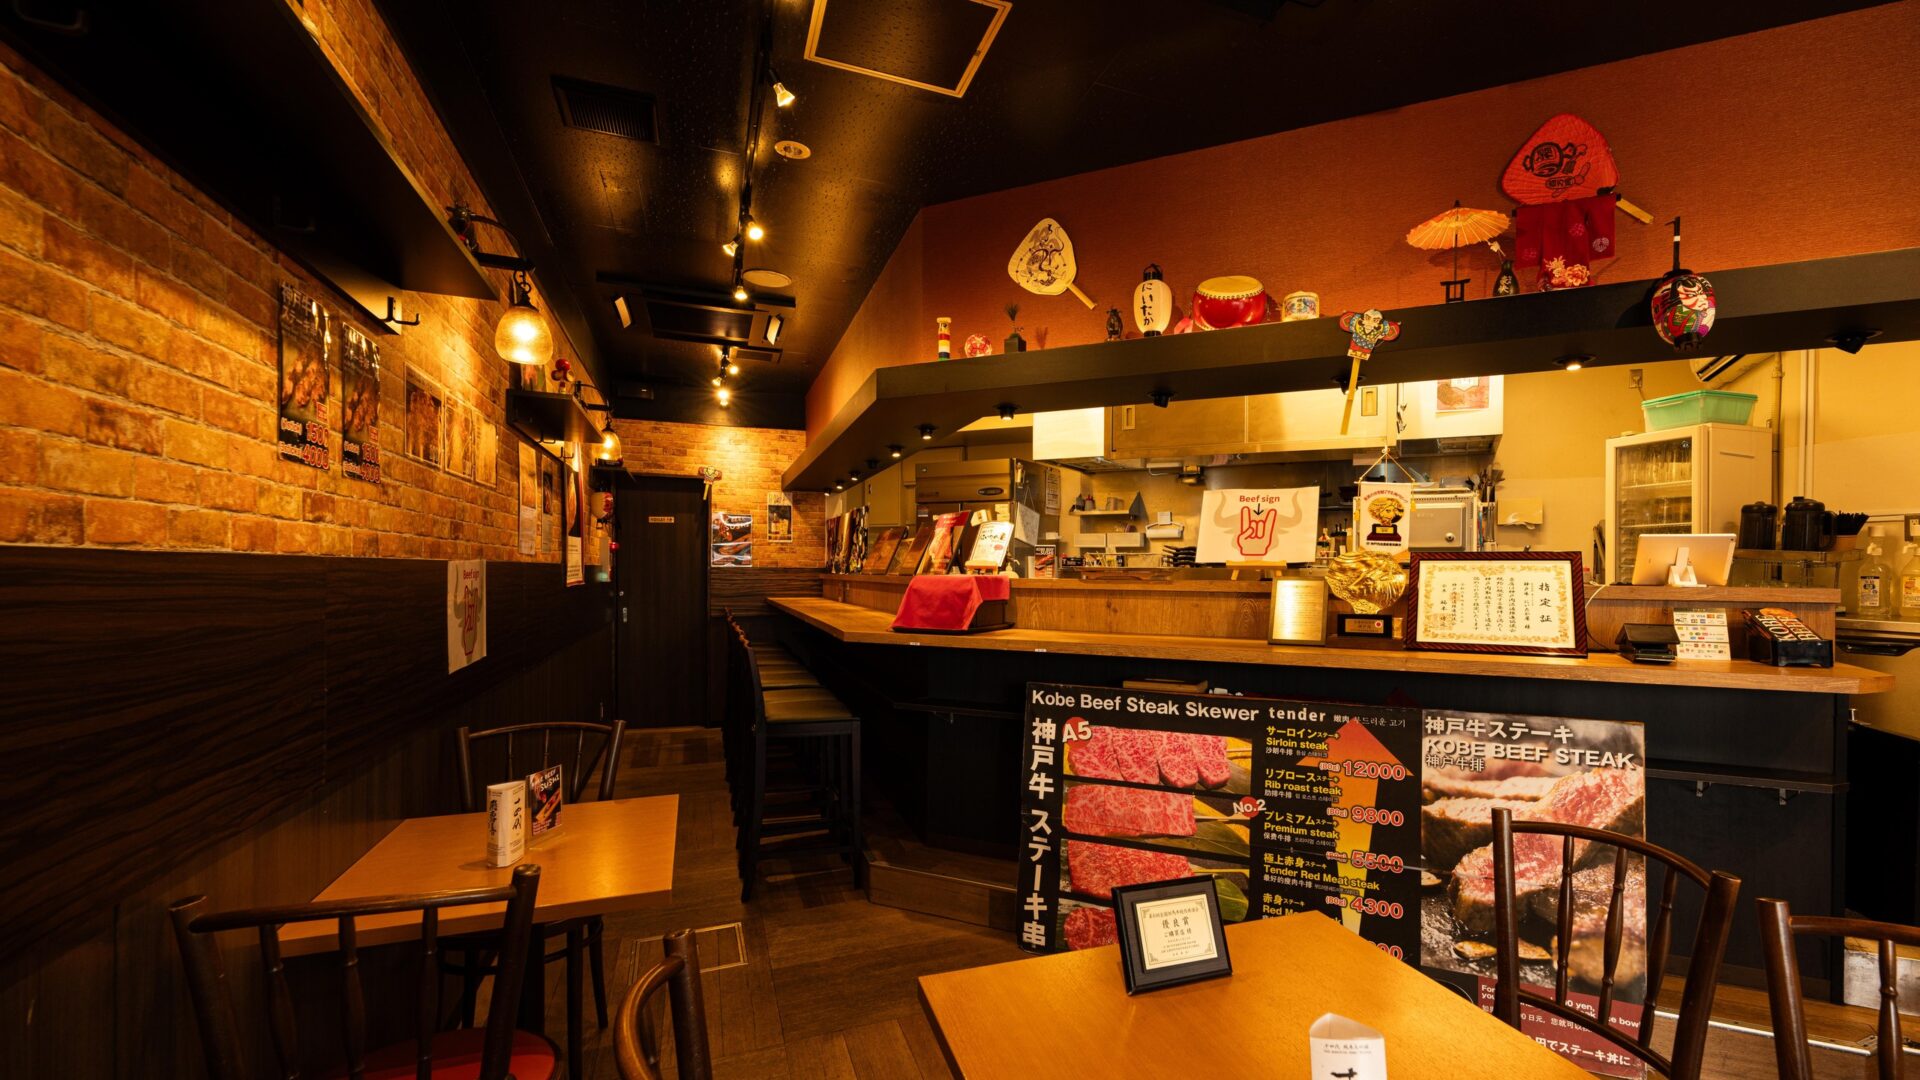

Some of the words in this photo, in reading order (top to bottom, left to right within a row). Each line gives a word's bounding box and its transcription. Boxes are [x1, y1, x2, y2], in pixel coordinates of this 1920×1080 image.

[1140, 283, 1153, 326] にいたか
[1239, 494, 1260, 503] Beef
[1262, 494, 1280, 504] sign
[1538, 582, 1552, 623] 指定証
[1032, 690, 1075, 707] Kobe
[1080, 694, 1121, 710] Beef
[1126, 697, 1179, 715] Steak
[1185, 701, 1259, 721] Skewer
[1268, 707, 1326, 721] tender
[1062, 720, 1092, 743] A5
[1389, 719, 1406, 727] 고기
[1425, 716, 1574, 744] 神戸牛ステーキ
[1266, 737, 1297, 748] Sirloin
[1300, 740, 1328, 751] steak
[1427, 739, 1486, 757] KOBE
[1491, 743, 1549, 761] BEEF
[1555, 748, 1636, 770] STEAK
[1343, 760, 1406, 781] 12000
[540, 774, 560, 792] SUSHI
[1264, 780, 1281, 789] Rib
[1283, 783, 1310, 792] roast
[1313, 785, 1341, 796] steak
[1232, 799, 1267, 814] No.2
[1351, 806, 1404, 827] 9800
[1022, 717, 1057, 949] 神戸牛ステーキ串
[1264, 822, 1308, 836] Premium
[1310, 829, 1340, 840] steak
[1352, 851, 1404, 874] 5500
[1263, 864, 1298, 878] Tender
[1300, 870, 1320, 881] Red
[1323, 873, 1348, 886] Meat
[1350, 877, 1380, 891] steak
[1263, 904, 1282, 914] Red
[1351, 897, 1404, 919] 4300
[1575, 1002, 1596, 1012] yen,
